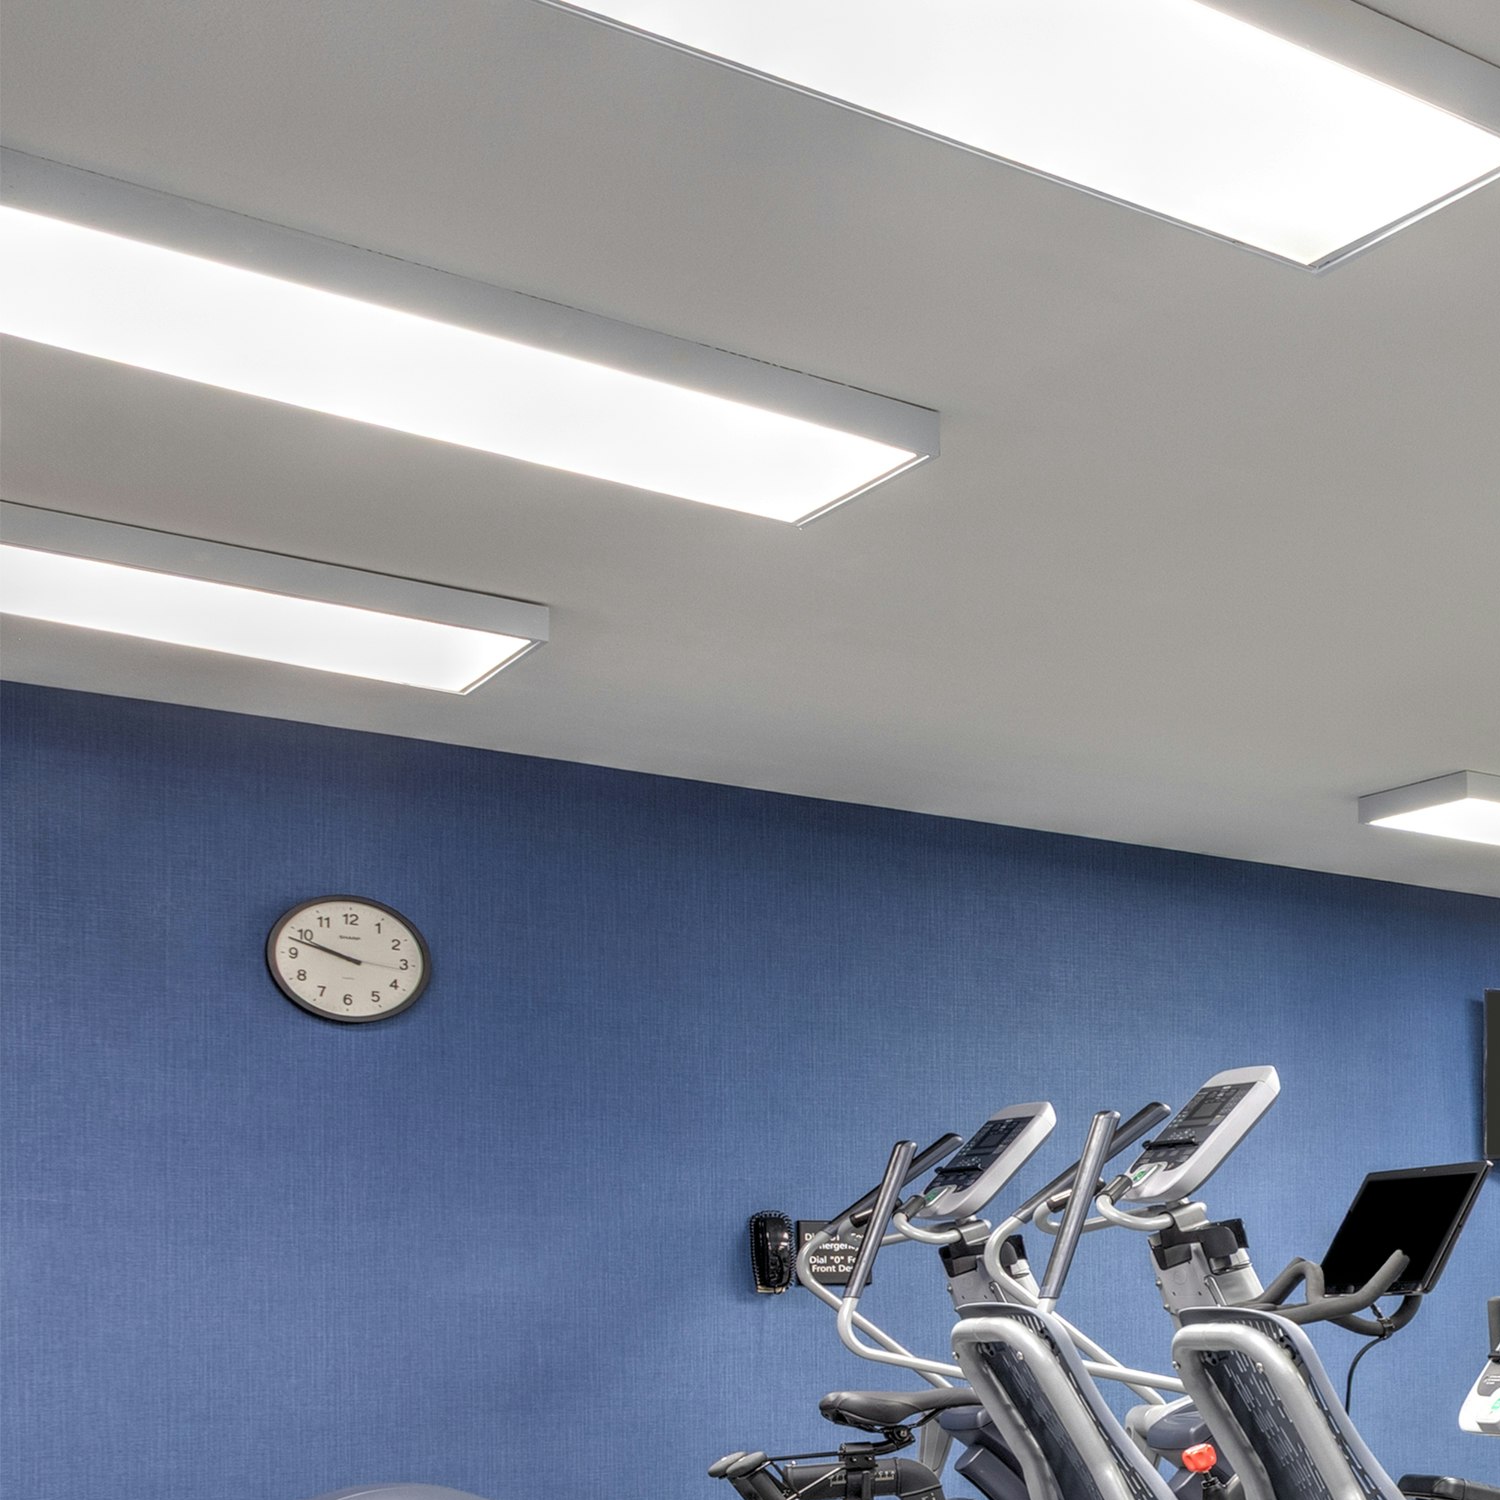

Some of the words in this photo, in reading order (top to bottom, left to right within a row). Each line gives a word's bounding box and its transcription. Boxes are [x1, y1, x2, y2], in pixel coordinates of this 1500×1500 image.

[316, 916, 330, 929] 11
[342, 913, 359, 926] 12
[375, 922, 382, 934] 1
[298, 929, 313, 941] 10
[391, 939, 401, 951] 2
[288, 947, 298, 959] 9
[398, 959, 409, 971] 3
[296, 969, 307, 981] 8
[389, 979, 399, 990] 4
[317, 985, 327, 997] 7
[370, 991, 380, 1002] 5
[343, 994, 353, 1006] 6
[809, 1256, 827, 1264] Dial
[812, 1265, 836, 1273] Front
